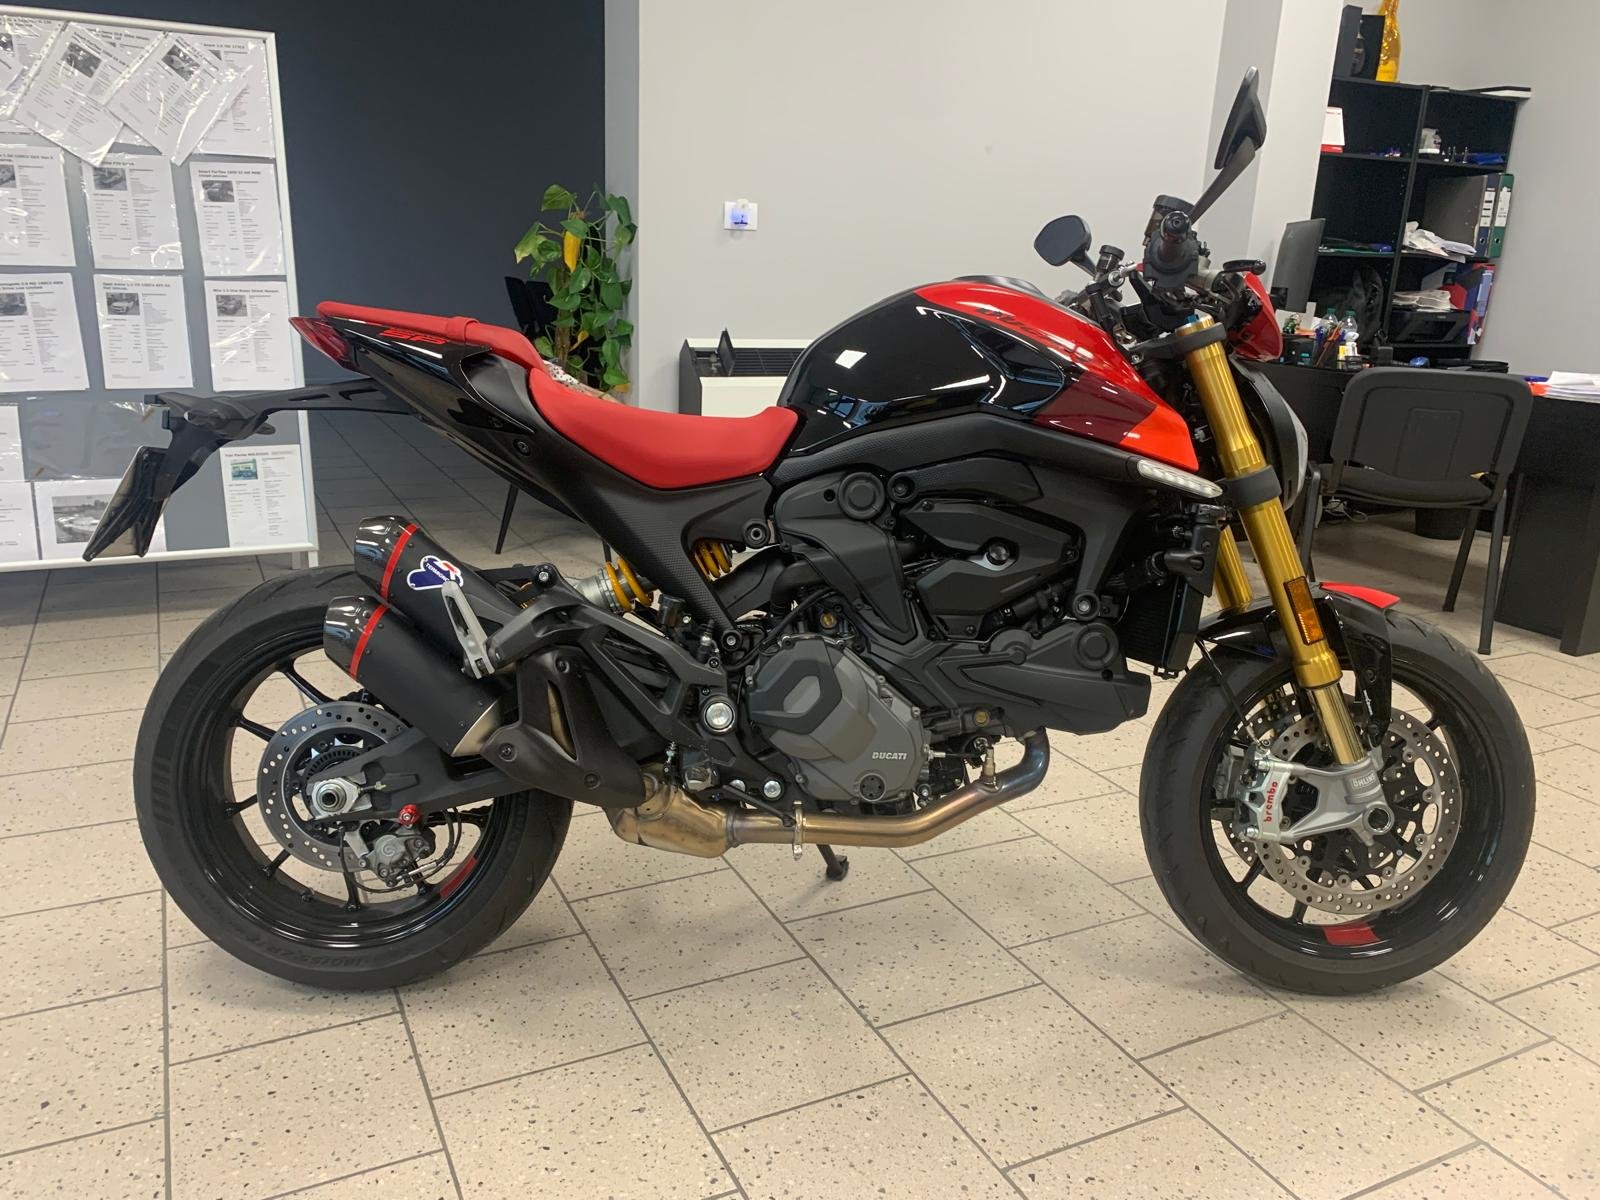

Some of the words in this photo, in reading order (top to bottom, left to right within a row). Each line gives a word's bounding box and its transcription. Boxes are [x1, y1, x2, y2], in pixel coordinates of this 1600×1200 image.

[379, 328, 446, 343] SP
[872, 752, 907, 760] DUCATI
[1263, 781, 1279, 823] brembo
